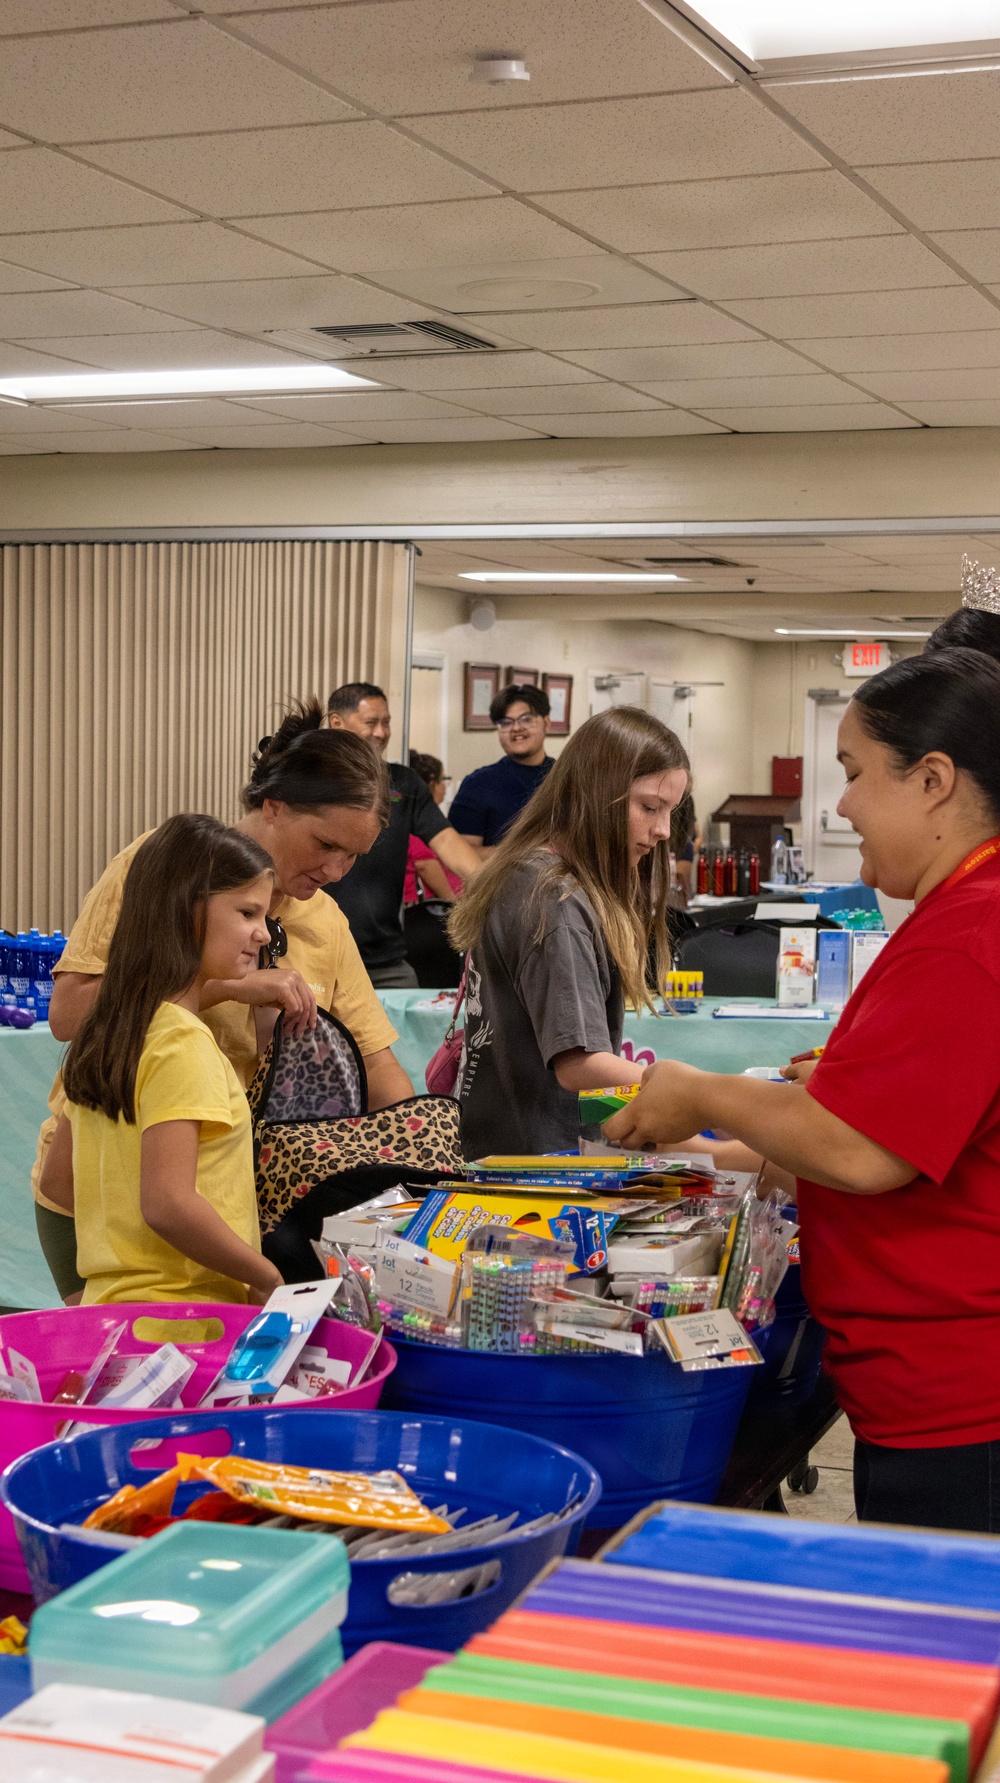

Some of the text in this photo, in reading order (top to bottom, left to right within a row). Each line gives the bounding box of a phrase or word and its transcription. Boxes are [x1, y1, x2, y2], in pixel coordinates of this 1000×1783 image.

[852, 643, 882, 666] EXIT
[964, 845, 997, 871] Barstow
[462, 1053, 480, 1097] EMPYRE
[470, 1206, 482, 1217] de
[432, 1207, 457, 1238] de Color
[585, 1214, 599, 1230] 12
[385, 1239, 400, 1251] Jot
[382, 1255, 396, 1269] Jot
[399, 1278, 413, 1293] 12
[704, 1323, 719, 1335] 12
[729, 1336, 744, 1347] Jot
